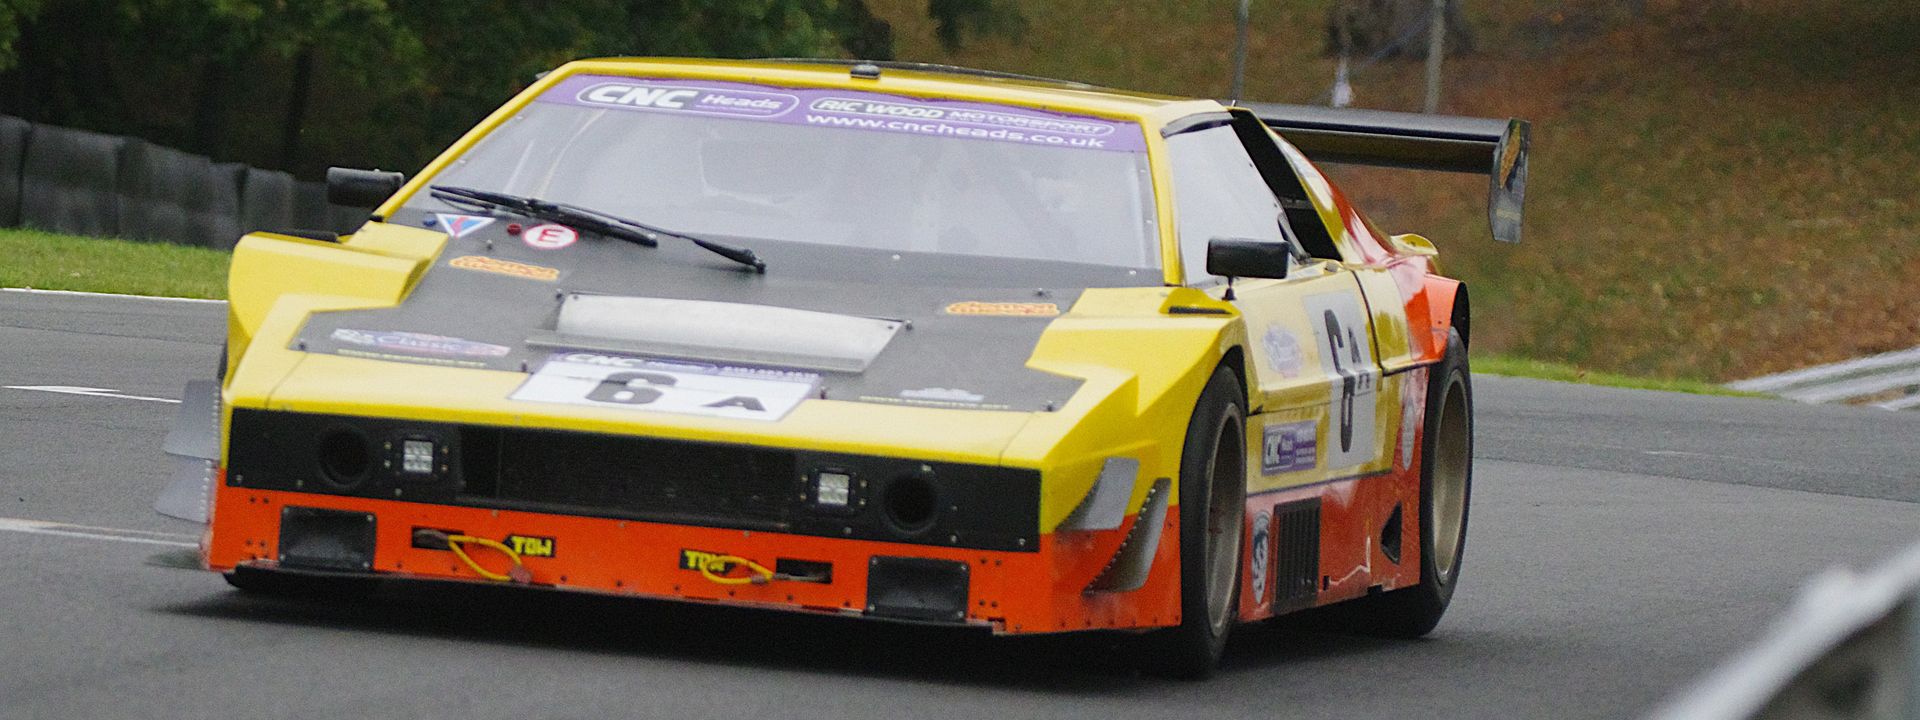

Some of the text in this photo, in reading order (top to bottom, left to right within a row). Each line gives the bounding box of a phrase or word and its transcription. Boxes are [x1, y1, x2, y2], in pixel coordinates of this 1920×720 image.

[588, 85, 699, 109] CNC
[702, 93, 783, 110] Heads
[817, 99, 1107, 132] RIC WOOD MOTORSPORT
[806, 114, 1107, 147] www.cncheads.co.uk
[538, 227, 564, 244] E
[565, 353, 644, 368] CNC
[584, 371, 767, 412] 6 A
[511, 535, 552, 557] TOW
